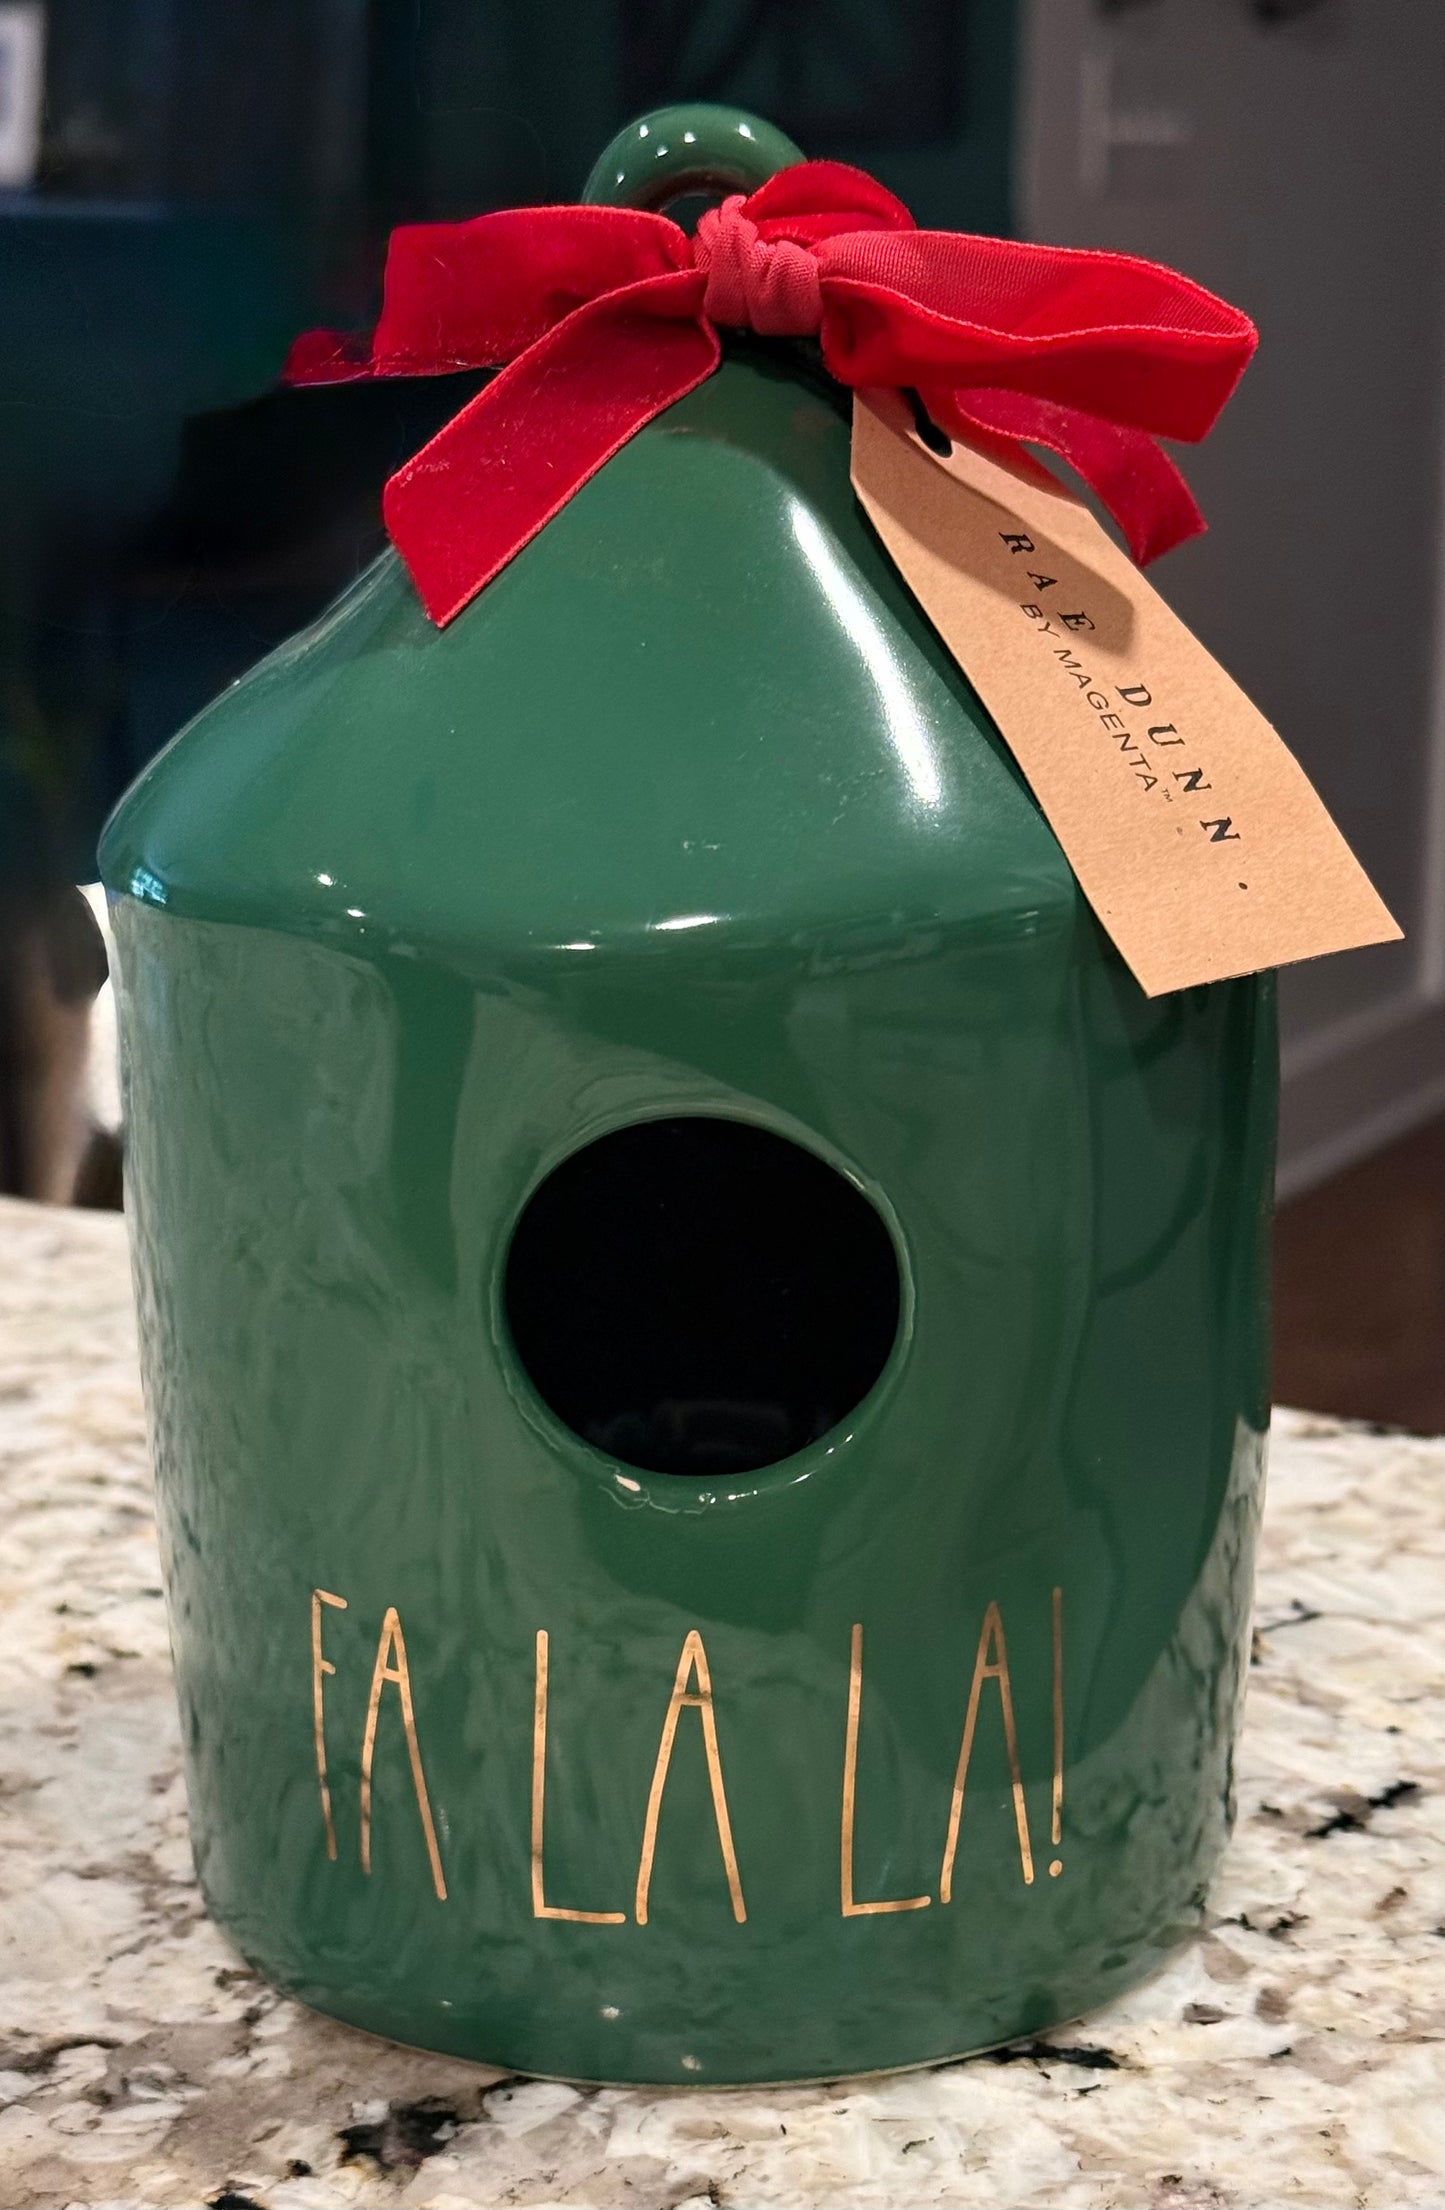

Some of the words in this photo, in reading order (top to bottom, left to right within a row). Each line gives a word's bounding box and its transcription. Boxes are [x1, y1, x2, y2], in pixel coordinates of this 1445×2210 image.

[1000, 532, 1096, 632] RAE
[1115, 684, 1240, 843] DUNN
[1019, 604, 1060, 638] BY
[312, 1588, 447, 1901] FA
[532, 1629, 747, 1925] LA
[840, 1586, 1064, 1918] LA!
